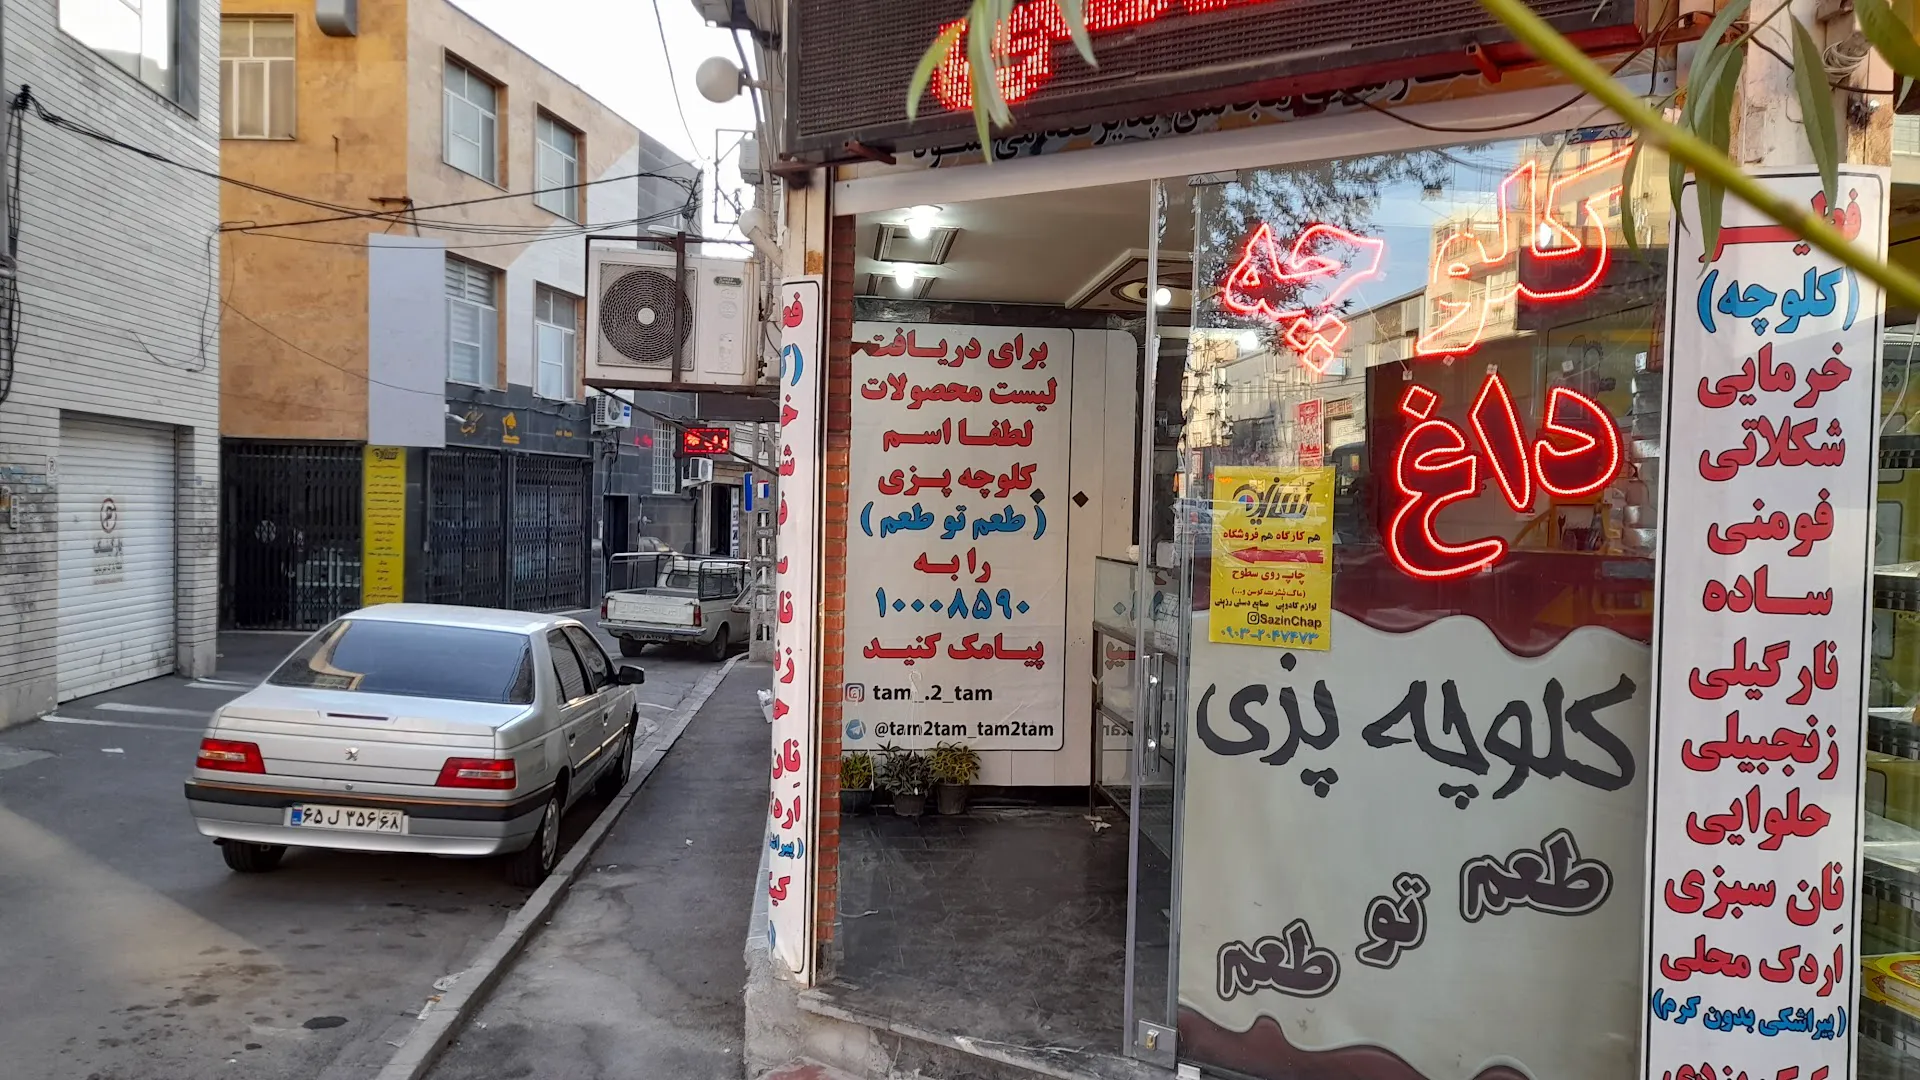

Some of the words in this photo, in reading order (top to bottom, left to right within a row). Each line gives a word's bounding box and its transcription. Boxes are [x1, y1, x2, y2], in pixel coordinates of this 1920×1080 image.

[1697, 266, 1860, 336] (کلوچه)
[870, 327, 982, 367] دریافت
[987, 333, 1048, 369] برای
[861, 373, 983, 409] محصولات
[1698, 342, 1852, 409] خرمایی
[989, 377, 1057, 411] لیست
[883, 418, 951, 452] اسم
[958, 418, 1033, 447] لطفا
[1698, 415, 1846, 481] شکلاتی
[878, 465, 951, 498] پزی
[958, 462, 1037, 498] کلوچه
[1390, 370, 1622, 578] داغ
[940, 504, 966, 540] تو
[1261, 532, 1273, 542] هم
[1307, 533, 1321, 544] هم
[1707, 488, 1834, 557] فومنی
[913, 552, 960, 581] به
[967, 547, 991, 583] را
[1232, 568, 1258, 580] سطوح
[1261, 571, 1280, 581] روی
[1282, 570, 1305, 585] چاپ
[875, 587, 1030, 619] ۱۰۰۰۸۵۹۰
[1252, 600, 1269, 611] صنایع
[1300, 602, 1317, 611] لوازم
[1703, 564, 1833, 615] ساده
[1260, 613, 1322, 630] SazinChap
[863, 632, 942, 666] کنید
[947, 632, 1045, 671] پیامک
[1688, 637, 1839, 705] نارگیلی
[874, 720, 1054, 739] @tam2tam_tam2tam
[1197, 652, 1340, 798] پزی
[1362, 673, 1637, 810] کلوچه
[1681, 710, 1840, 780] زنجبیلی
[1686, 784, 1831, 851] حلوایی
[1459, 828, 1613, 923] طعم
[1664, 865, 1776, 919] سبزی
[1786, 861, 1844, 926] نان
[1355, 872, 1431, 970] تو
[1217, 918, 1341, 1001] طعم
[1660, 934, 1752, 981] محلی
[1652, 988, 1701, 1024] کرم)
[1703, 1007, 1756, 1034] بدون
[1758, 1006, 1847, 1040] (پیراشکی
